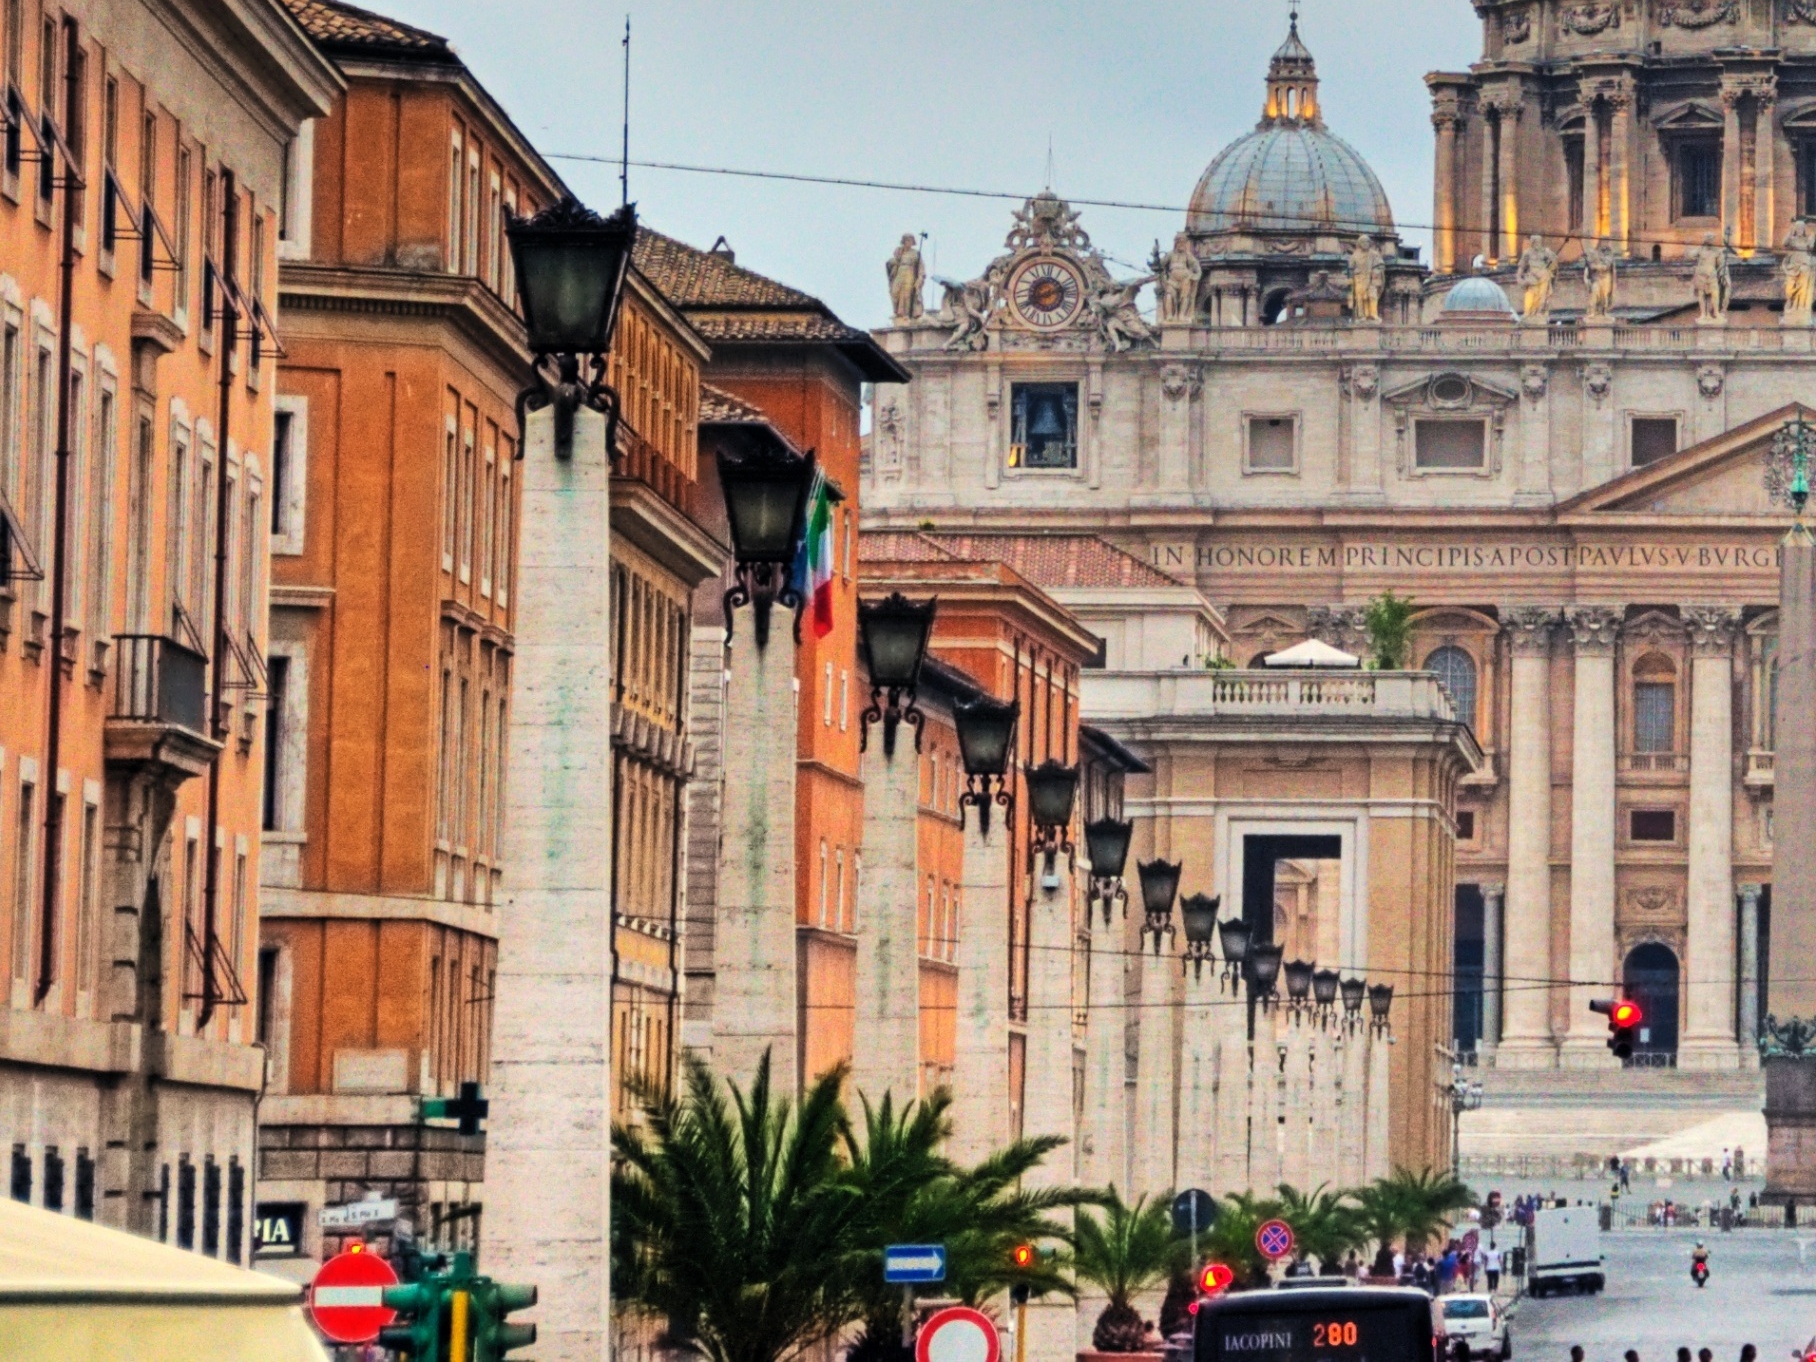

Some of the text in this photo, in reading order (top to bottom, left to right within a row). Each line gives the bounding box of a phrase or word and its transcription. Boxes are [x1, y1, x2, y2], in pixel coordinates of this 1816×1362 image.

[1153, 546, 1183, 566] IN
[1198, 547, 1337, 567] HONOREM
[1345, 547, 1484, 567] PRINCIPIS
[1489, 546, 1574, 567] APOST
[1579, 546, 1667, 567] PAVLVS
[1674, 546, 1691, 567] V
[1225, 1332, 1291, 1351] IACOPINI
[1314, 1322, 1357, 1347] 280
